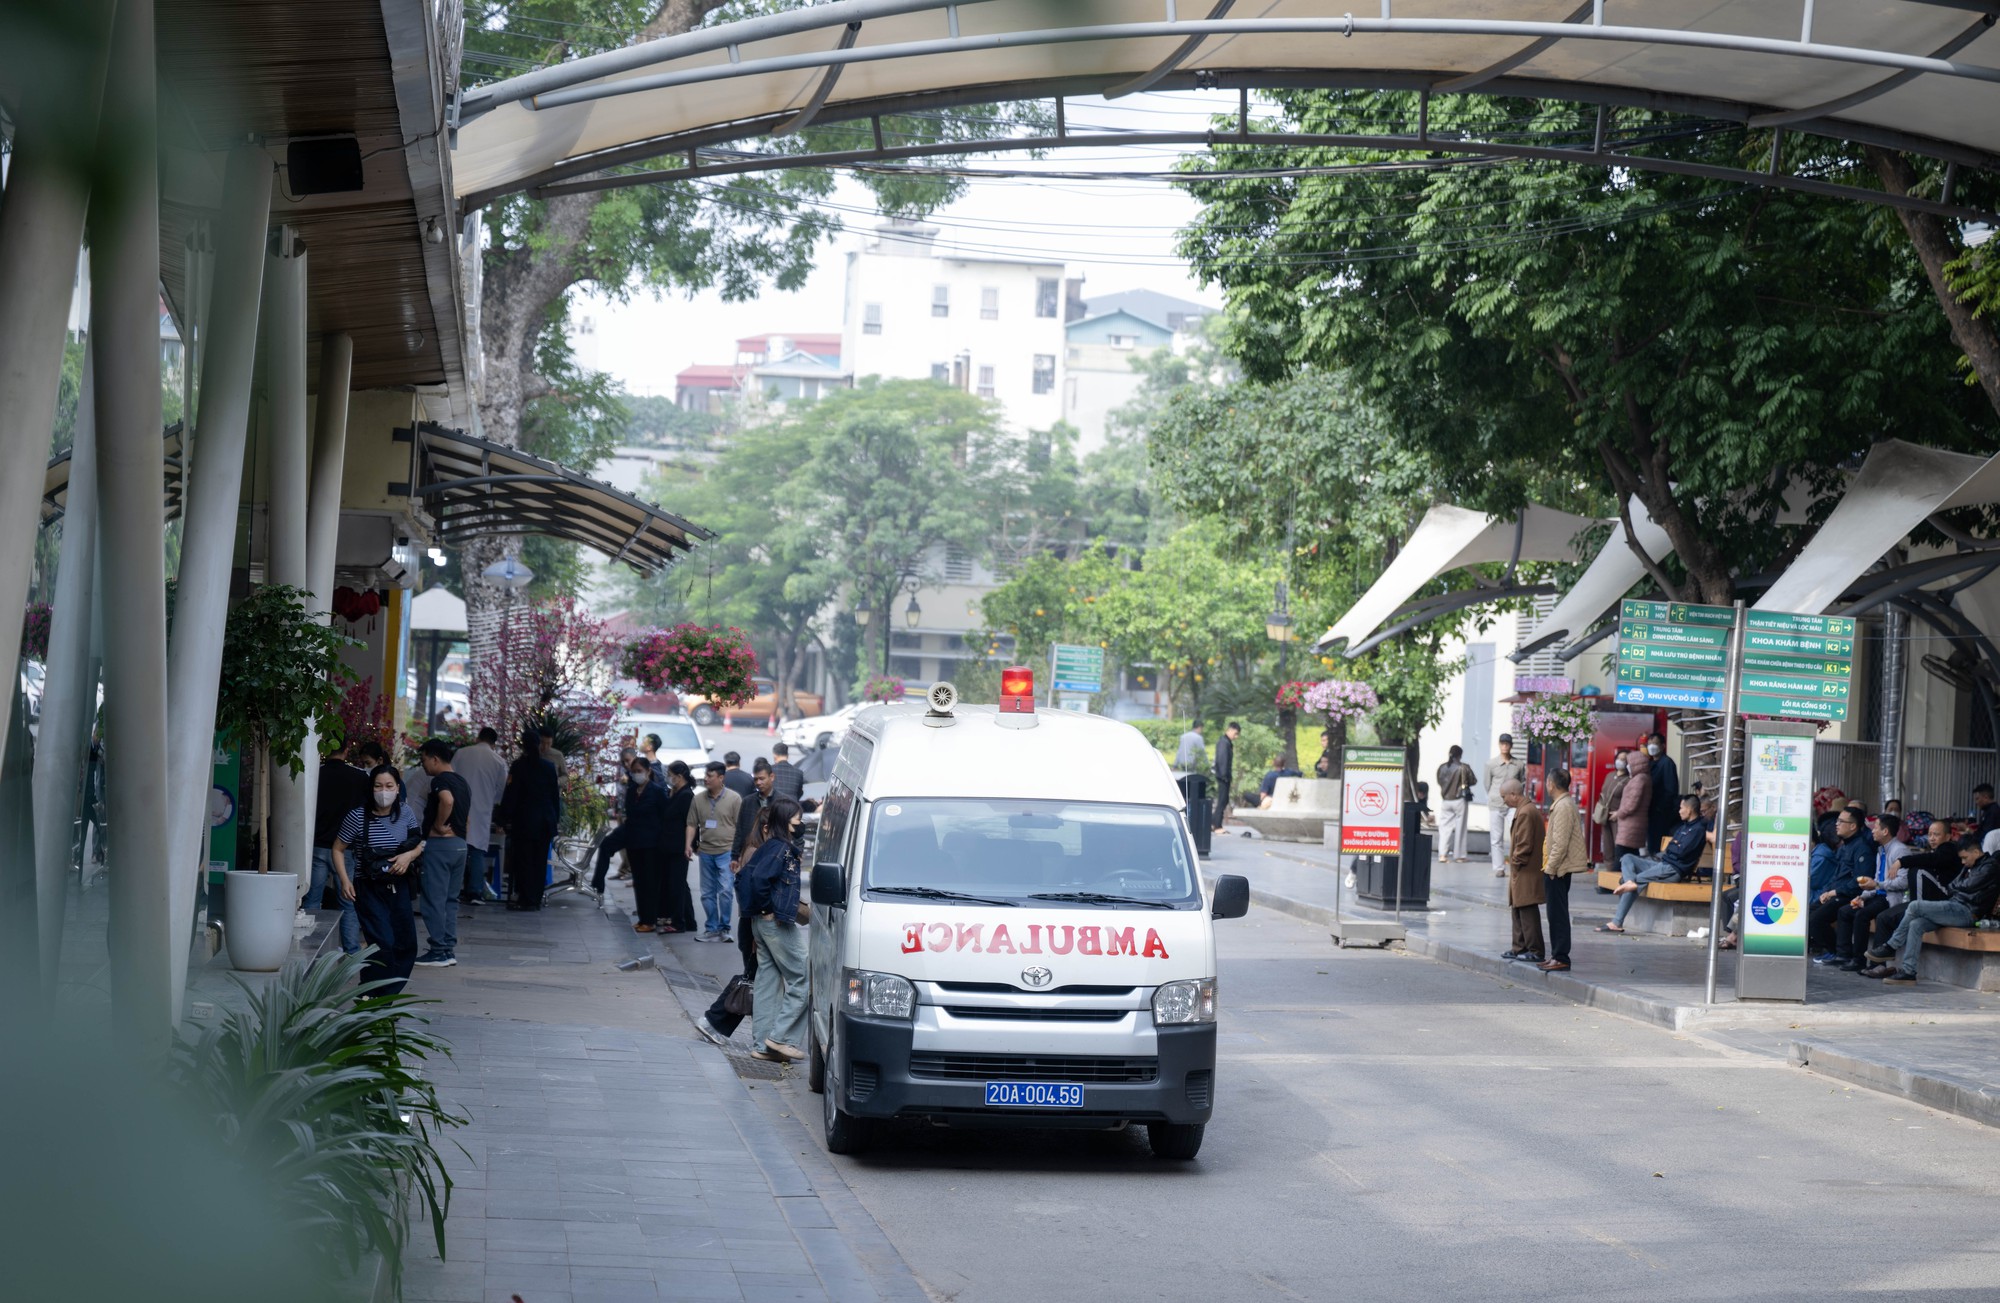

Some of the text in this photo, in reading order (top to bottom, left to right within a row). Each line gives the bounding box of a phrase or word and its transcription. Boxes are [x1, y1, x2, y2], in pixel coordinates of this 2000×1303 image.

[1679, 612, 1684, 620] C
[1778, 622, 1790, 630] NIỆU
[1752, 637, 1821, 649] KHOA KHÁM BỆNH
[1828, 643, 1838, 651] K2
[1827, 664, 1837, 672] K1
[1769, 681, 1787, 689] RĂNG
[1801, 701, 1818, 709] CỔNG
[989, 1085, 1080, 1104] 20A-004.59
